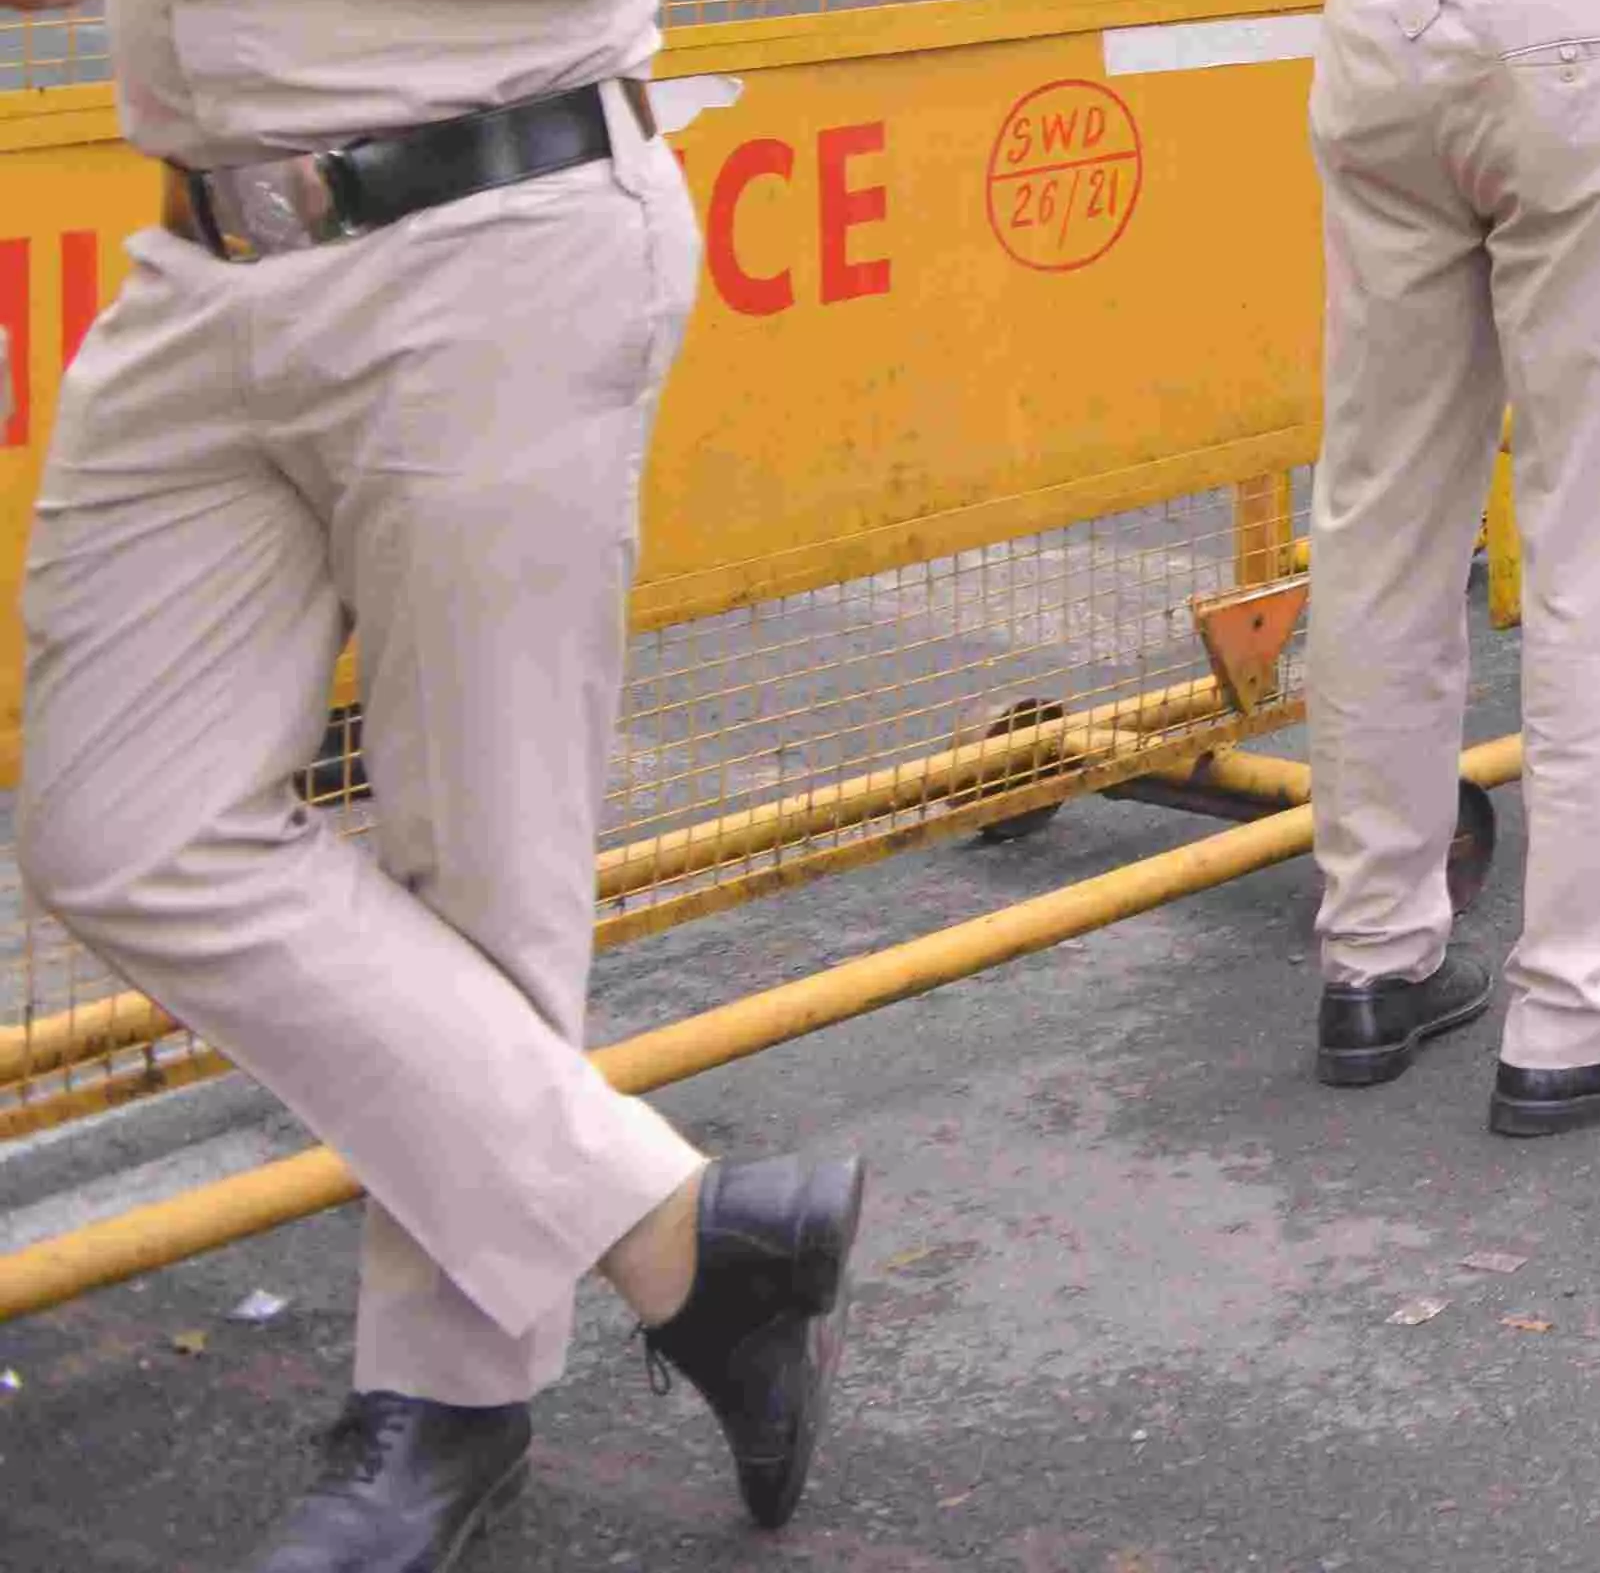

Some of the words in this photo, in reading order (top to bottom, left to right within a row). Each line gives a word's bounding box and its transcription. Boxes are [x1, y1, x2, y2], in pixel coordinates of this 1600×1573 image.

[1007, 105, 1105, 164] SWD
[676, 120, 891, 317] CE
[1010, 168, 1120, 251] 26/21
